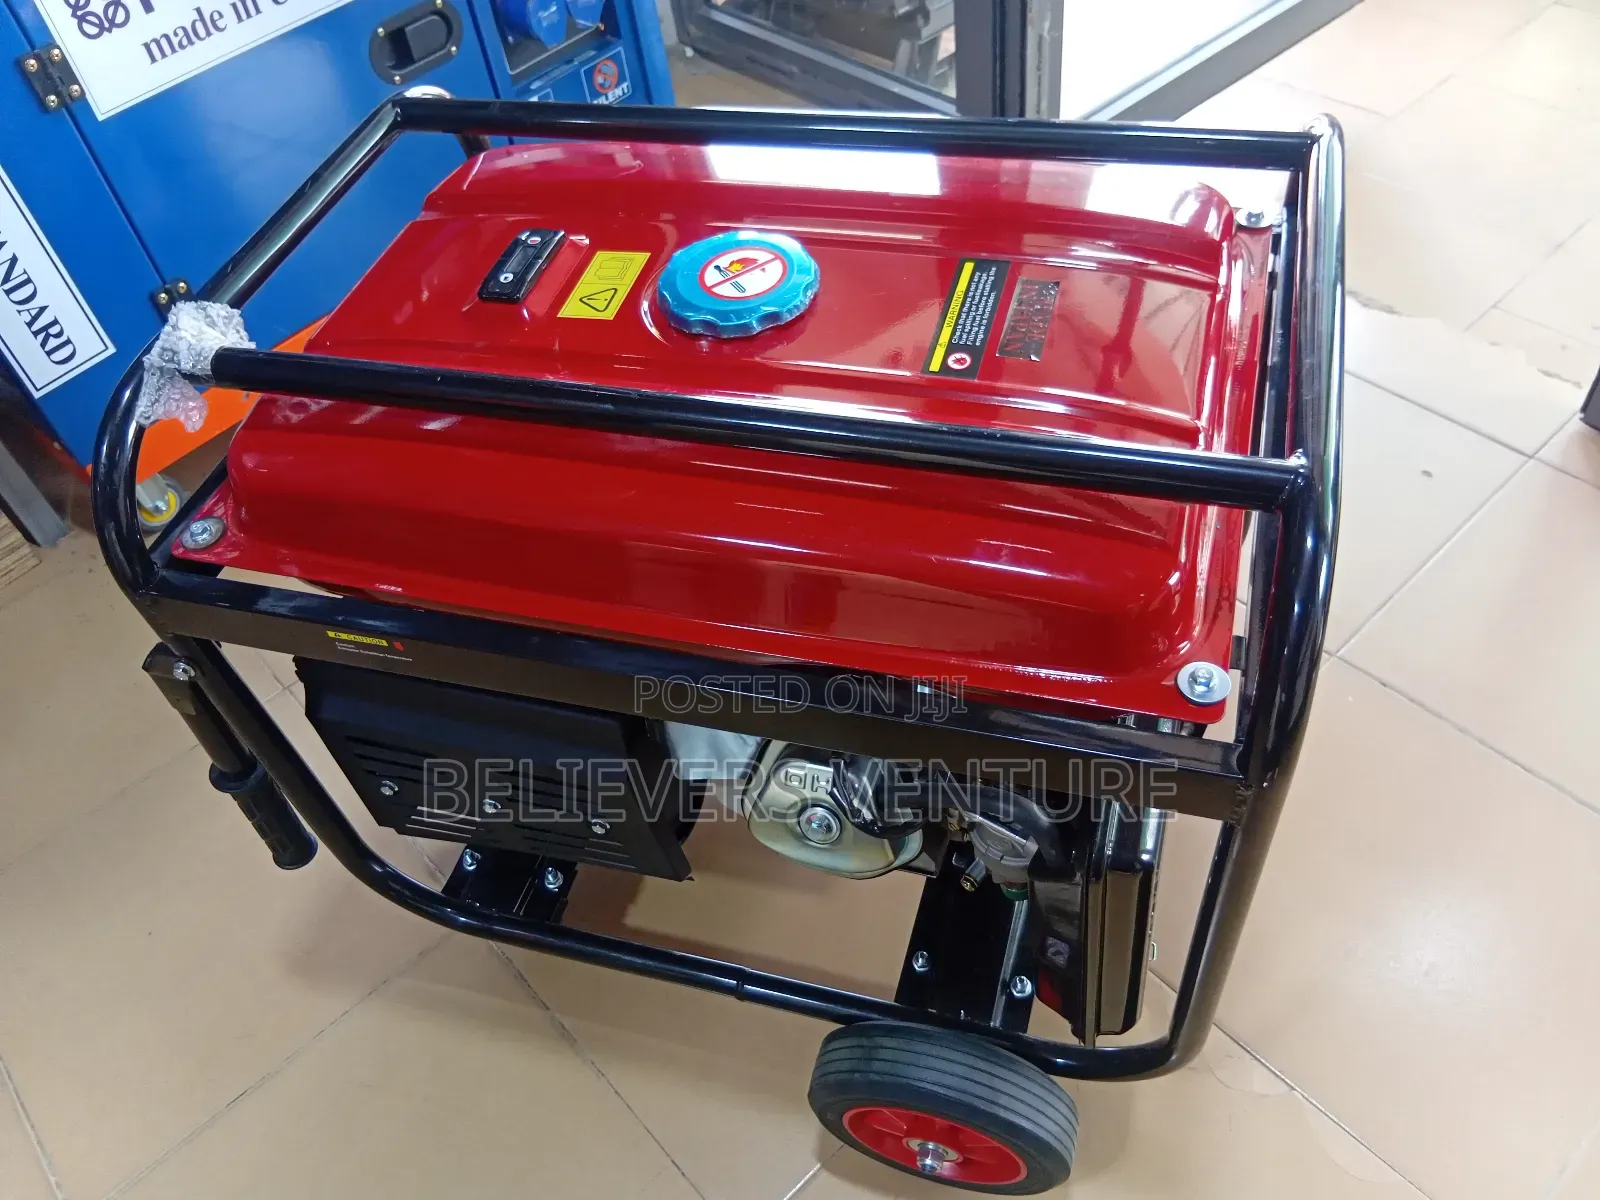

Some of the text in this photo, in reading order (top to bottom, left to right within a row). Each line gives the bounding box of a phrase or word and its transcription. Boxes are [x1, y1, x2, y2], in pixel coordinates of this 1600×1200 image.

[141, 6, 228, 65] made
[0, 239, 77, 366] NDARD
[946, 290, 964, 328] WARNING
[962, 297, 972, 312] there
[958, 312, 967, 325] that
[966, 326, 979, 346] Filling
[976, 296, 987, 315] before
[951, 324, 963, 344] Check
[959, 332, 968, 345] fuel
[975, 325, 986, 346] engine
[346, 634, 384, 645] CAUTION
